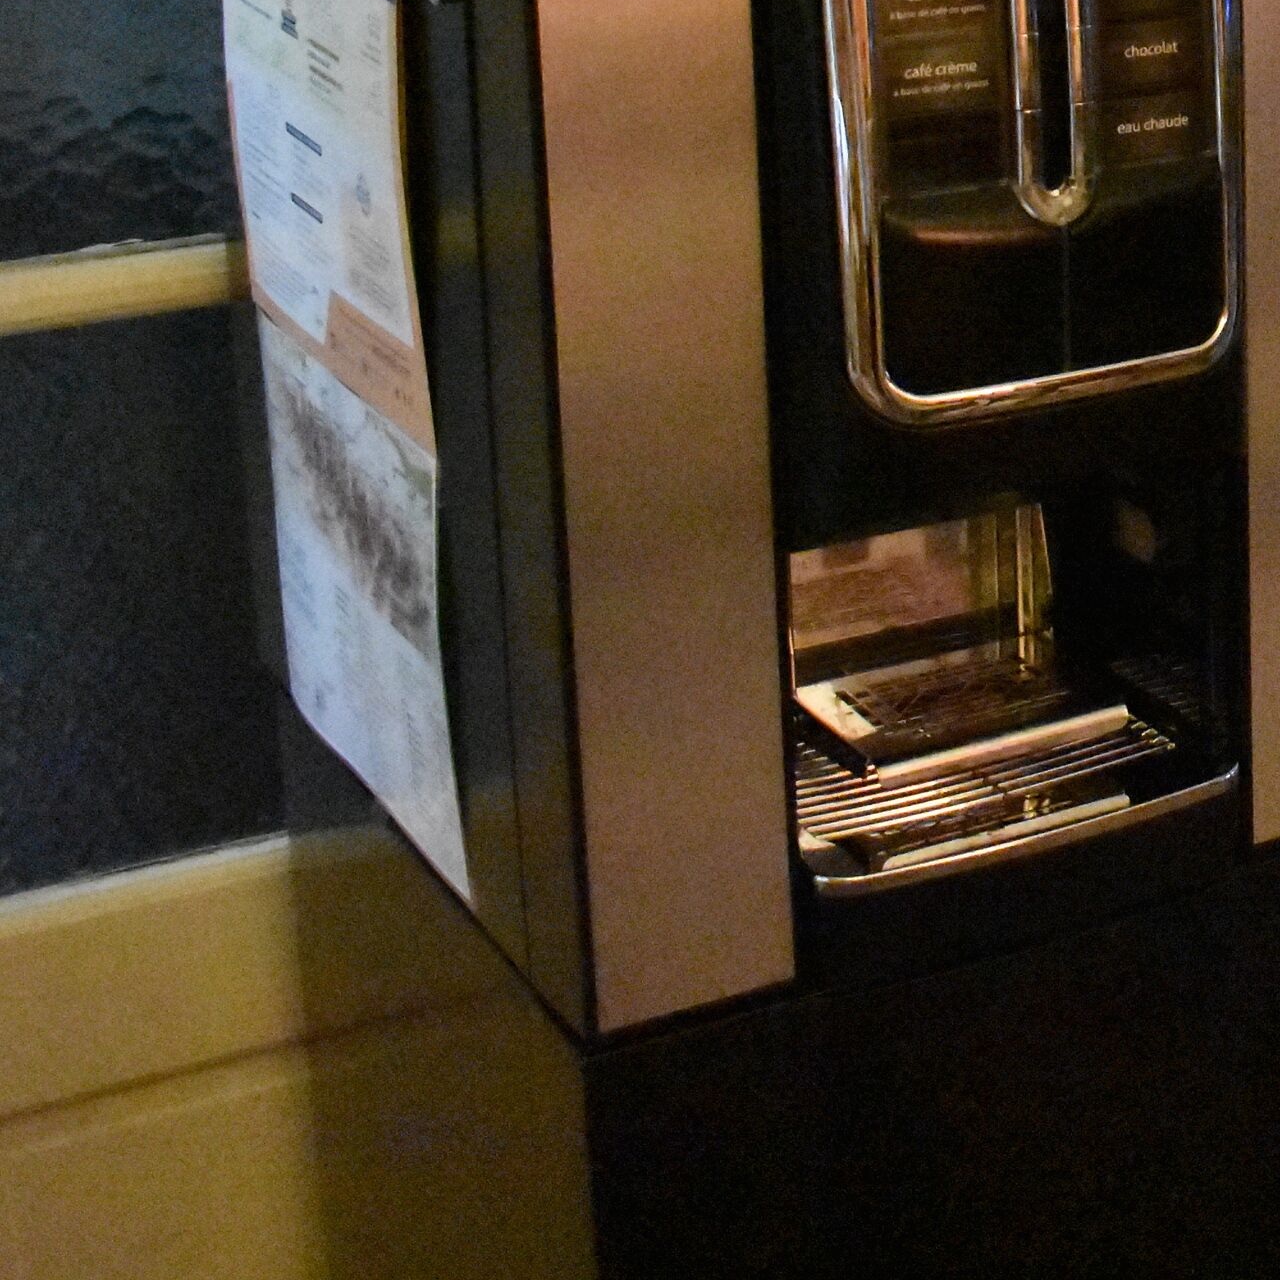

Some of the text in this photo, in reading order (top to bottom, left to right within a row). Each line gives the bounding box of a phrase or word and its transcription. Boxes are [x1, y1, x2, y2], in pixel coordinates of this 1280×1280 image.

[1124, 41, 1178, 59] chocolat
[904, 61, 978, 80] café crème
[1117, 114, 1189, 135] eau chaude
